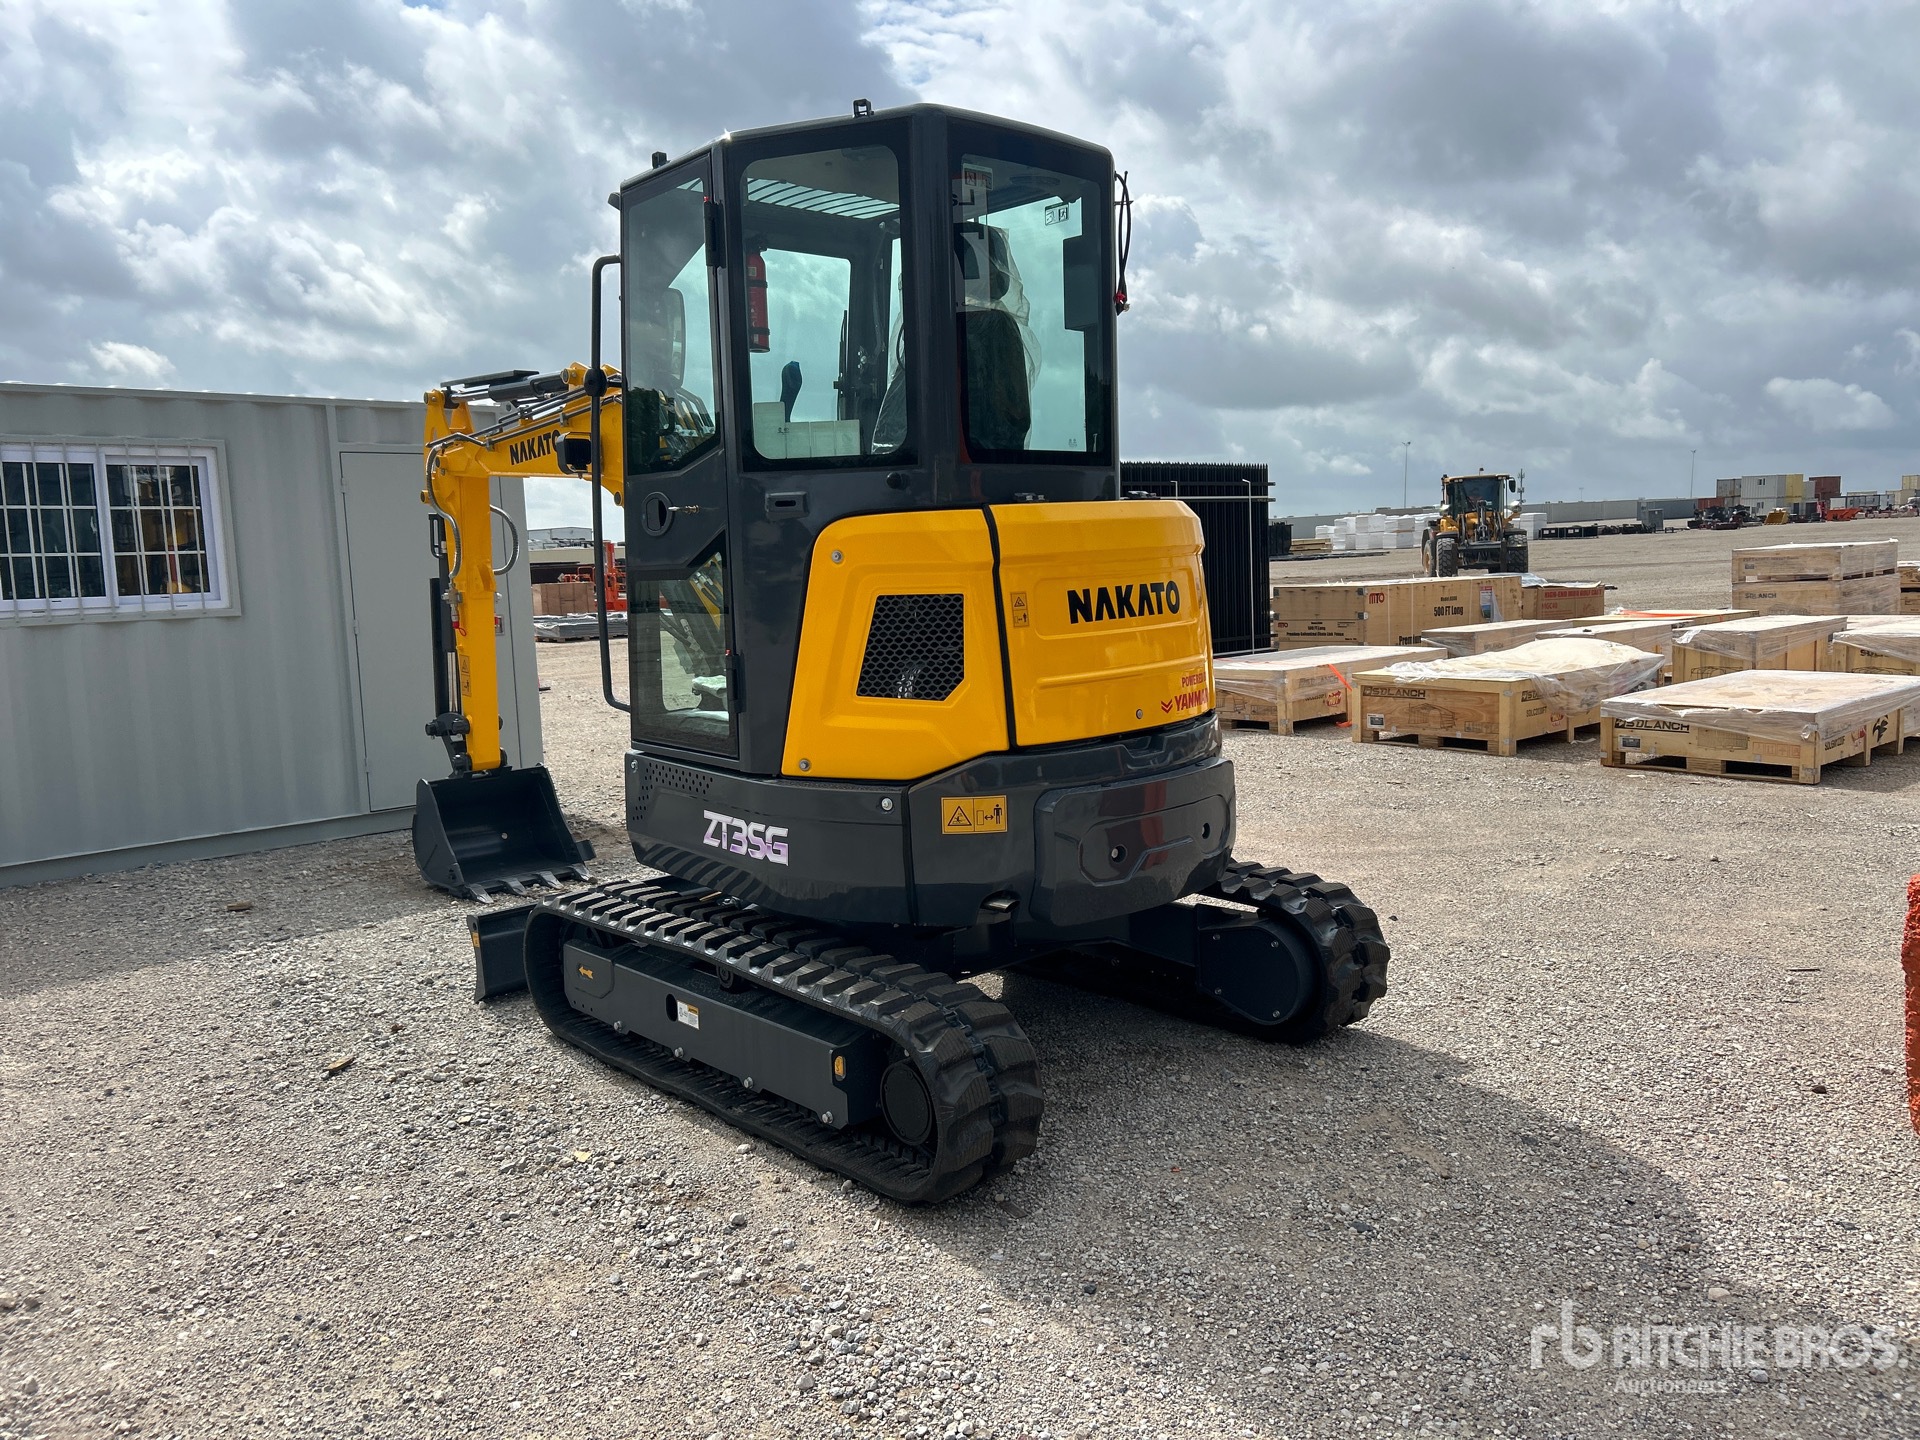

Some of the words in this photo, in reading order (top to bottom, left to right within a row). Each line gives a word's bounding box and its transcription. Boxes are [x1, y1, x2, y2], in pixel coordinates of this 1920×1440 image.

[1067, 580, 1180, 624] NAKATO
[1434, 606, 1445, 617] 500
[1445, 606, 1451, 615] FT
[1451, 605, 1464, 616] Long
[1372, 687, 1426, 698] SDLANCH
[1626, 719, 1690, 731] SDLANCH
